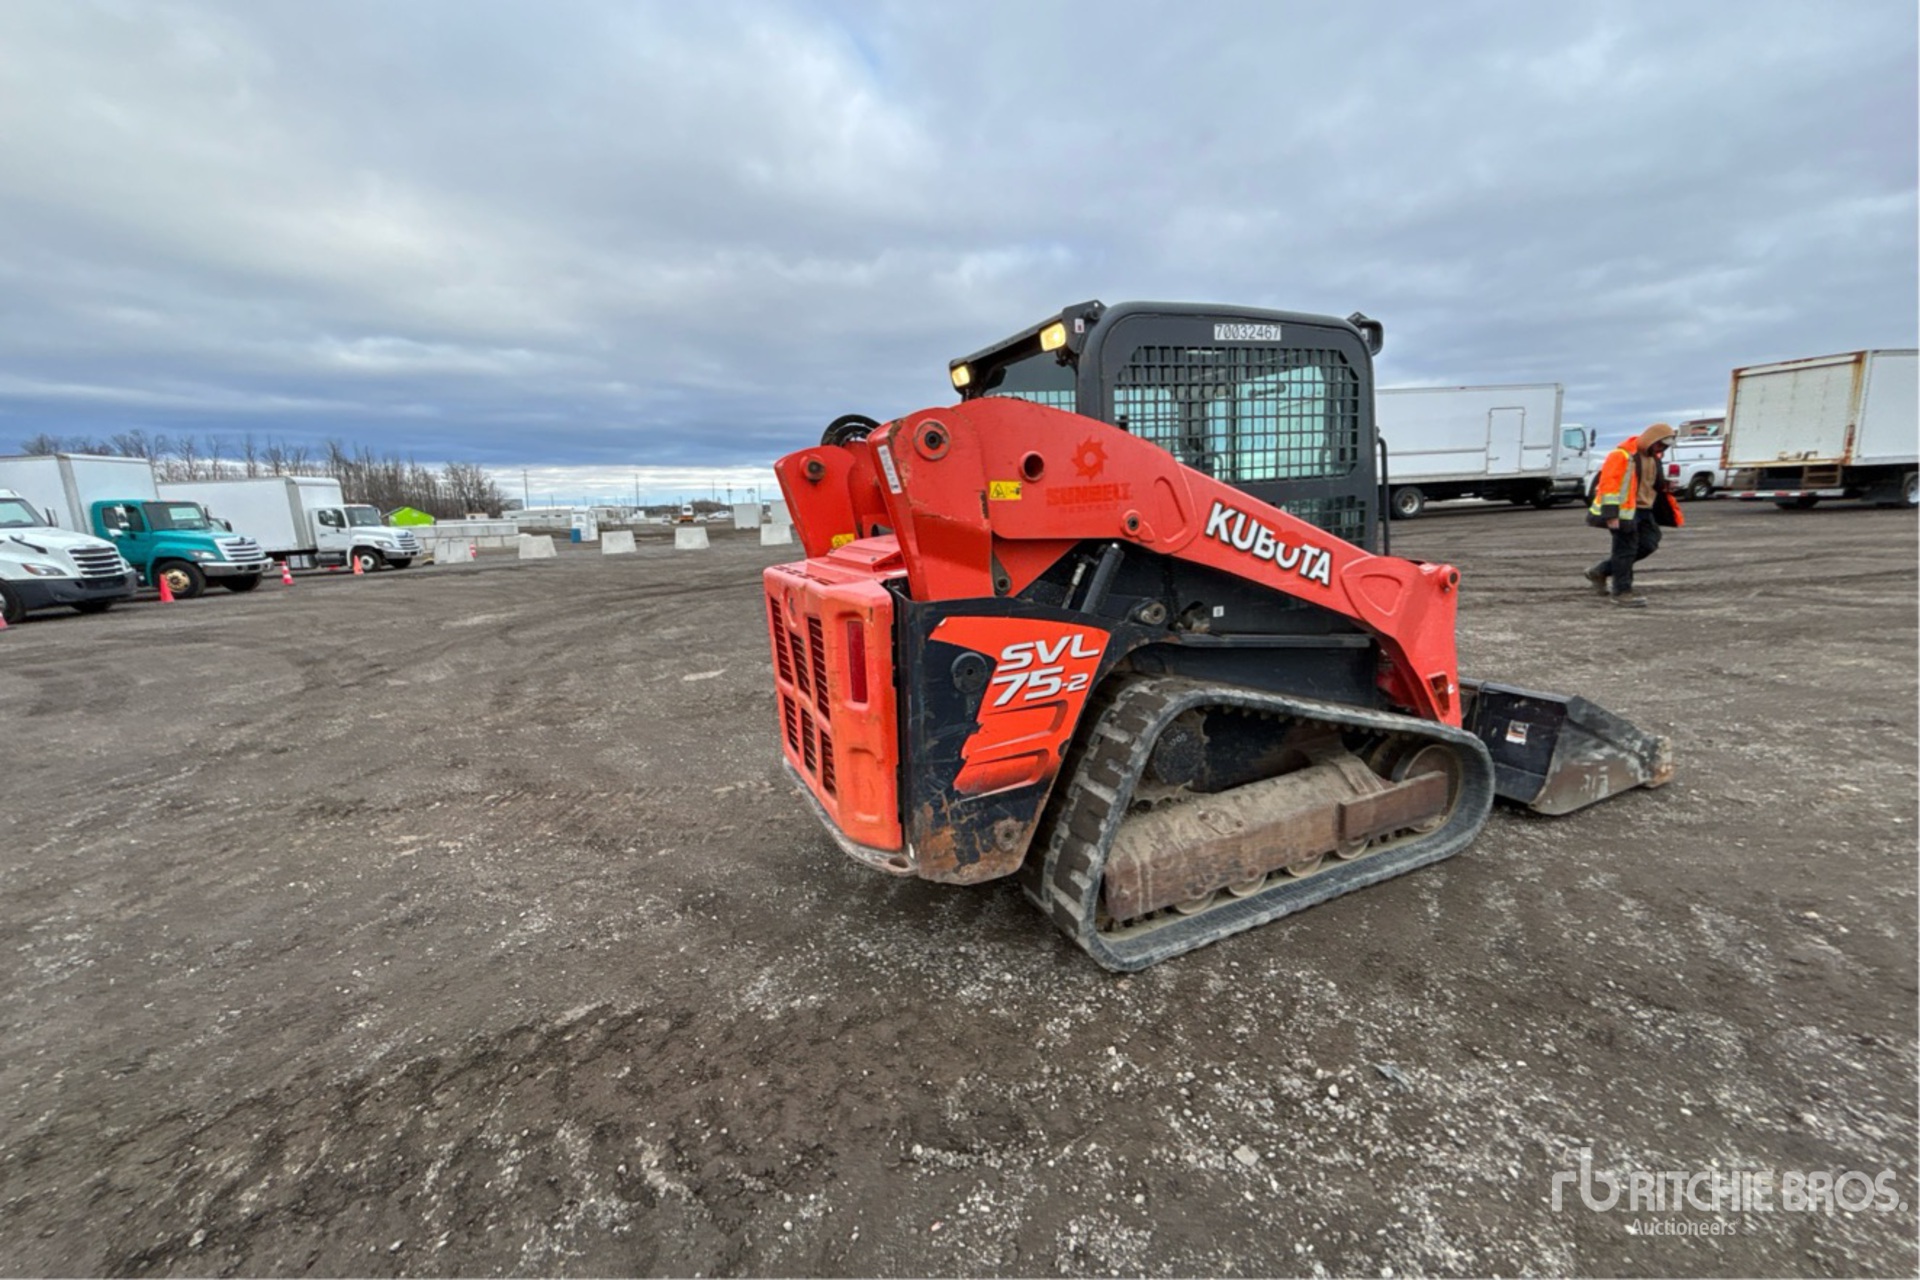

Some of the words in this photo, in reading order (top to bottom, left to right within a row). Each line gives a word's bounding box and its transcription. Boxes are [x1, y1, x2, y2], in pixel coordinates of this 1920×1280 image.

[1215, 323, 1281, 340] 70032467
[997, 634, 1100, 672] SVL
[992, 666, 1089, 707] 75-2
